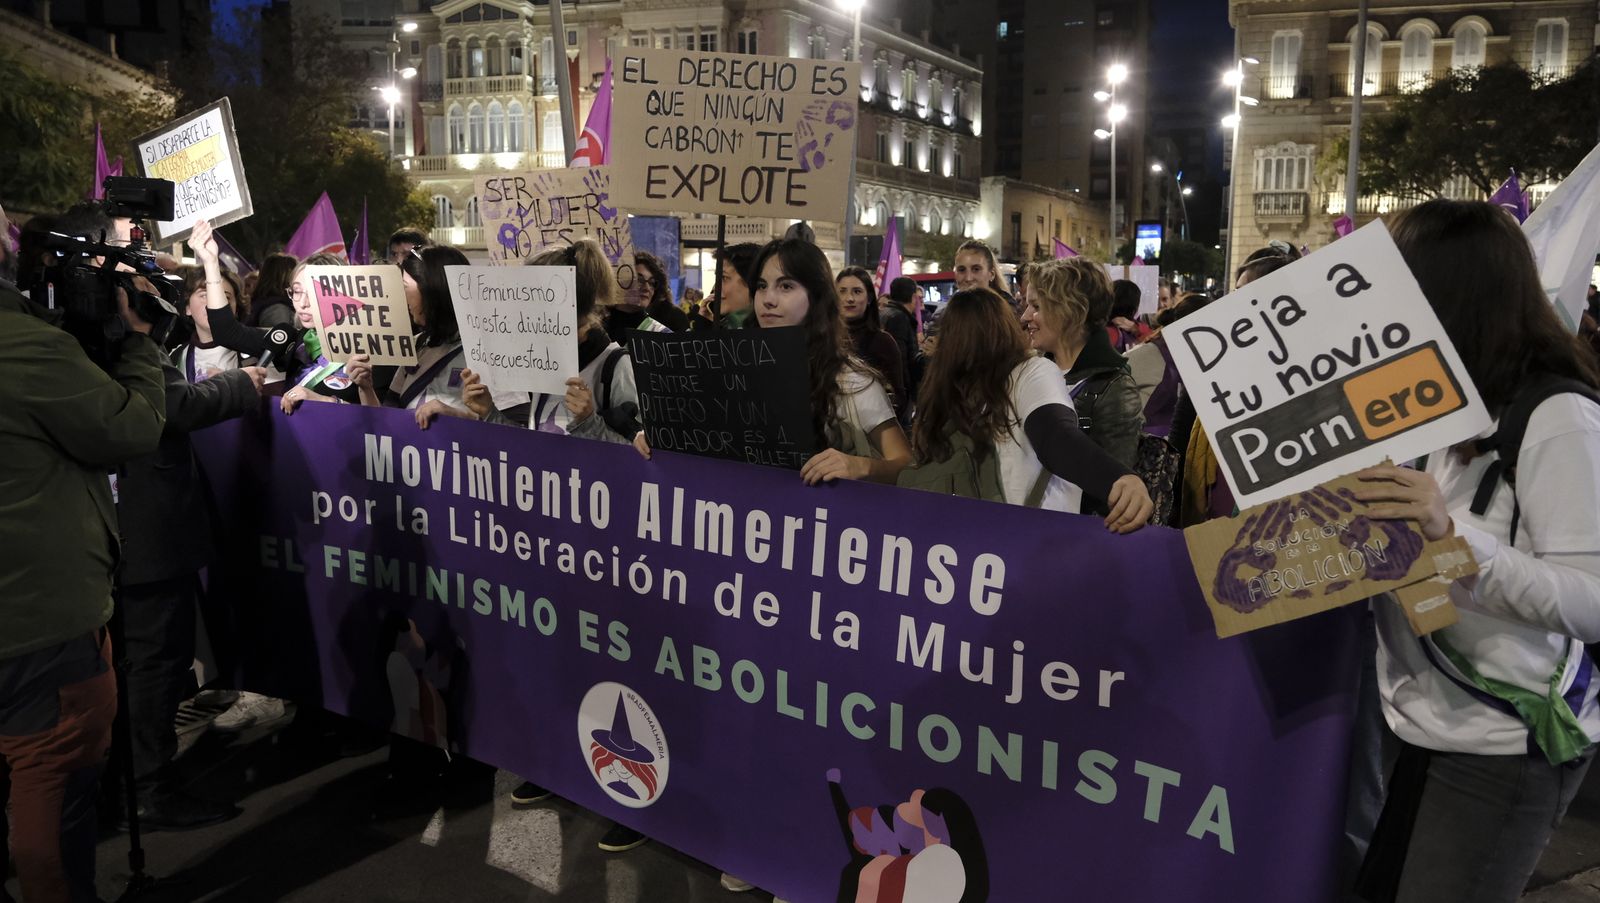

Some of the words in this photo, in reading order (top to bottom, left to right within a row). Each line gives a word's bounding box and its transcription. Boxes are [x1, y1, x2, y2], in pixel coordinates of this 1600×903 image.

[622, 56, 659, 85] EL
[678, 57, 797, 92] DERECHO
[811, 65, 848, 96] ES
[646, 89, 685, 117] QUE
[703, 93, 785, 125] NINGÚN
[145, 144, 158, 164] SI
[160, 123, 200, 157] DESAPARECE
[201, 119, 214, 137] LA
[756, 131, 794, 161] TE
[194, 168, 220, 193] SIRVE
[485, 176, 535, 203] SER
[645, 163, 809, 207] EXPLOTE
[516, 193, 608, 229] MUJER
[503, 229, 532, 260] NO
[458, 272, 472, 300] El
[476, 274, 555, 303] Feminismo
[331, 303, 392, 328] DATE
[466, 313, 480, 330] no
[482, 307, 512, 334] está
[517, 311, 571, 336] dividido
[1182, 295, 1307, 373] Deja
[1326, 262, 1372, 298] a
[327, 332, 414, 357] CUENTA
[490, 343, 559, 371] secuestrado
[632, 338, 650, 364] LA
[650, 338, 776, 370] DIFERENCIA
[650, 373, 704, 393] ENTRE
[723, 374, 748, 392] UN
[1211, 380, 1263, 420] tu
[1275, 322, 1411, 396] novio
[640, 392, 706, 423] PUTERO
[713, 396, 729, 425] Y
[738, 399, 769, 427] UN
[644, 425, 741, 456] VIOLADOR
[744, 430, 766, 444] ES
[744, 445, 812, 468] BILLETE
[364, 432, 611, 530] Movimiento
[636, 480, 1006, 617] Almeriense
[1288, 507, 1310, 524] LA
[1246, 539, 1389, 602] ABOLICIÓN
[311, 490, 377, 525] por
[396, 495, 430, 536] la
[448, 506, 688, 605] Liberación
[713, 572, 781, 628] de
[809, 590, 861, 652] la
[896, 614, 1126, 708] Mujer
[258, 534, 306, 574] EL
[322, 544, 559, 637] FEMINISMO
[577, 608, 632, 663] ES
[653, 635, 1236, 856] ABOLICIONISTA
